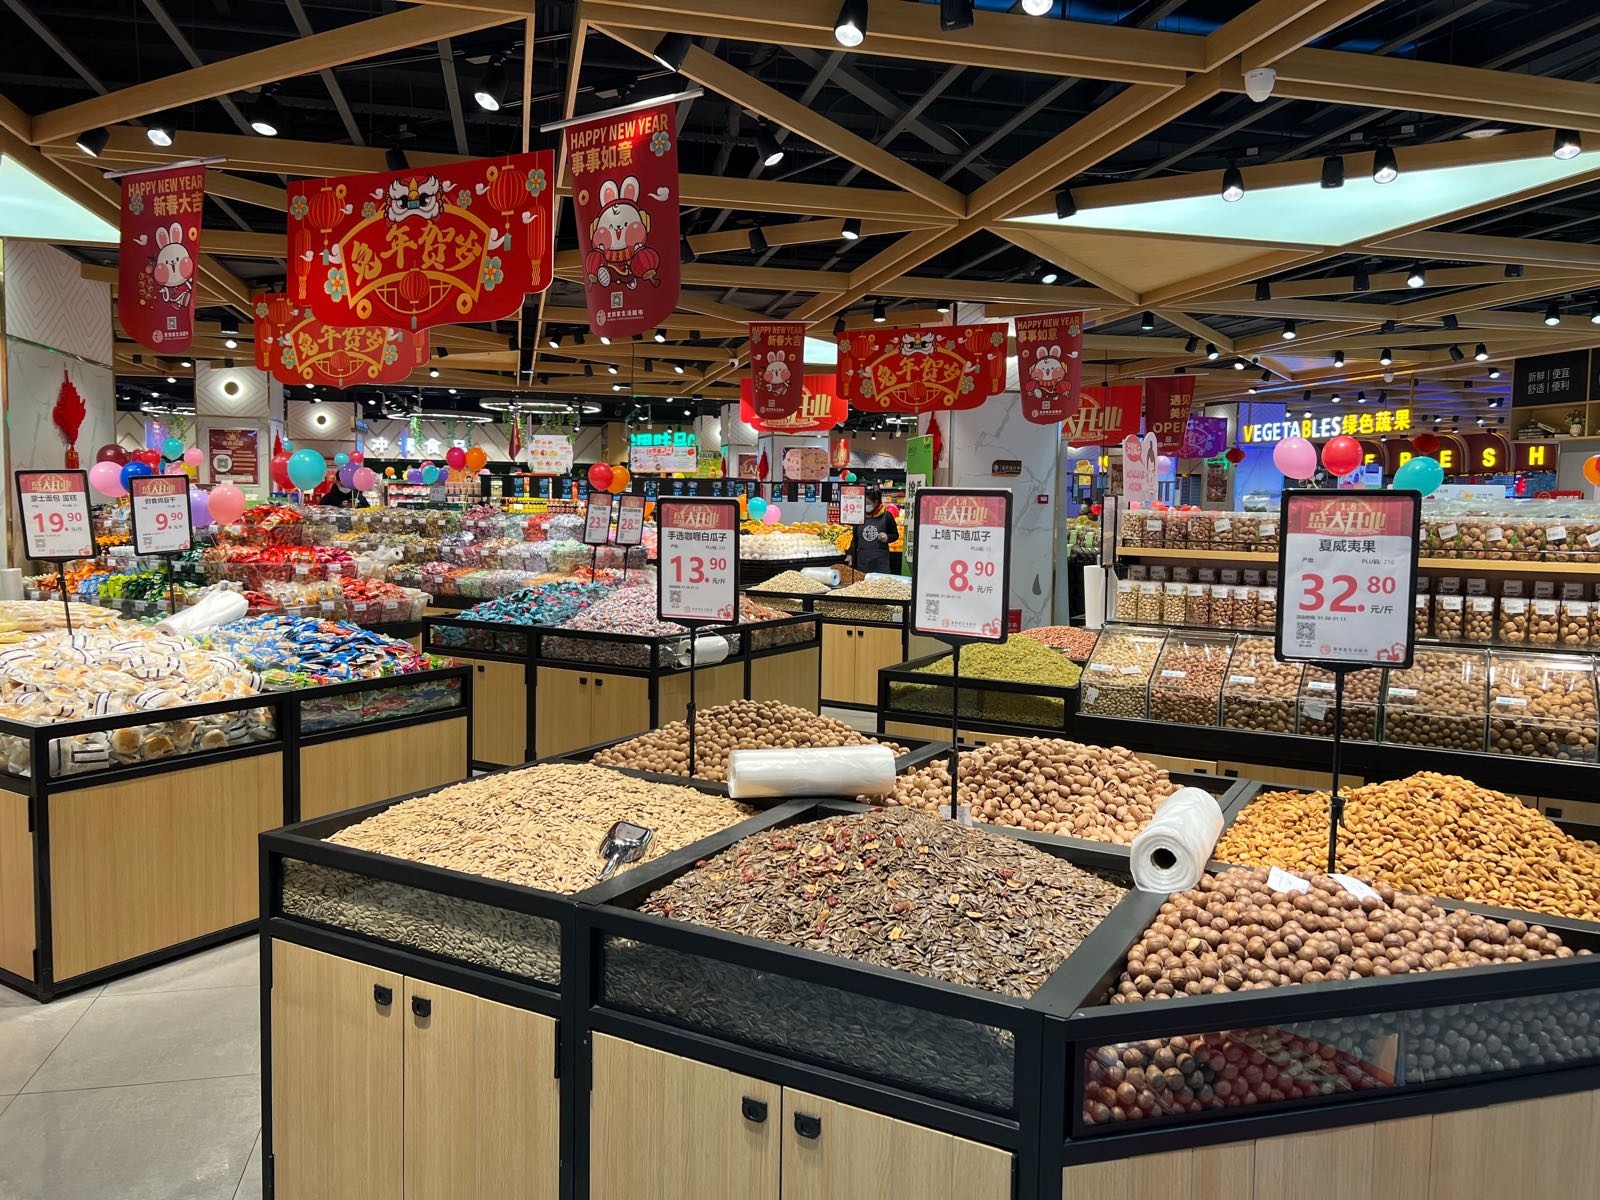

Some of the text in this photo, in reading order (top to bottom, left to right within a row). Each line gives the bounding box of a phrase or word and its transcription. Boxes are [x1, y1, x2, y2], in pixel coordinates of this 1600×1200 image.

[570, 113, 668, 150] HAPPY NEW YEAR
[571, 141, 632, 176] 事事如意
[128, 174, 203, 197] HAPPY NEW YEAR
[153, 191, 203, 216] 新春大吉
[351, 220, 482, 286] 兔年贺岁
[751, 326, 803, 335] HAPPY NEW YEAR
[1017, 316, 1080, 330] HAPPY NEW YEAR
[298, 325, 384, 359] 兔年贺岁
[767, 335, 801, 346] 新春大吉
[1018, 328, 1057, 343] 事事如意
[877, 356, 960, 389] 兔年贺岁
[1243, 409, 1412, 443] VEGETABLES 绿色蔬果
[933, 505, 988, 525] 盛大开业
[1341, 502, 1357, 512] 1.8
[1306, 510, 1386, 534] 盛大开业
[668, 530, 727, 542] 手选咖喱白瓜子
[931, 528, 991, 542] 上嗑下嗑瓜子
[1318, 538, 1376, 553] 夏威夷果
[1370, 604, 1394, 615] 元/斤
